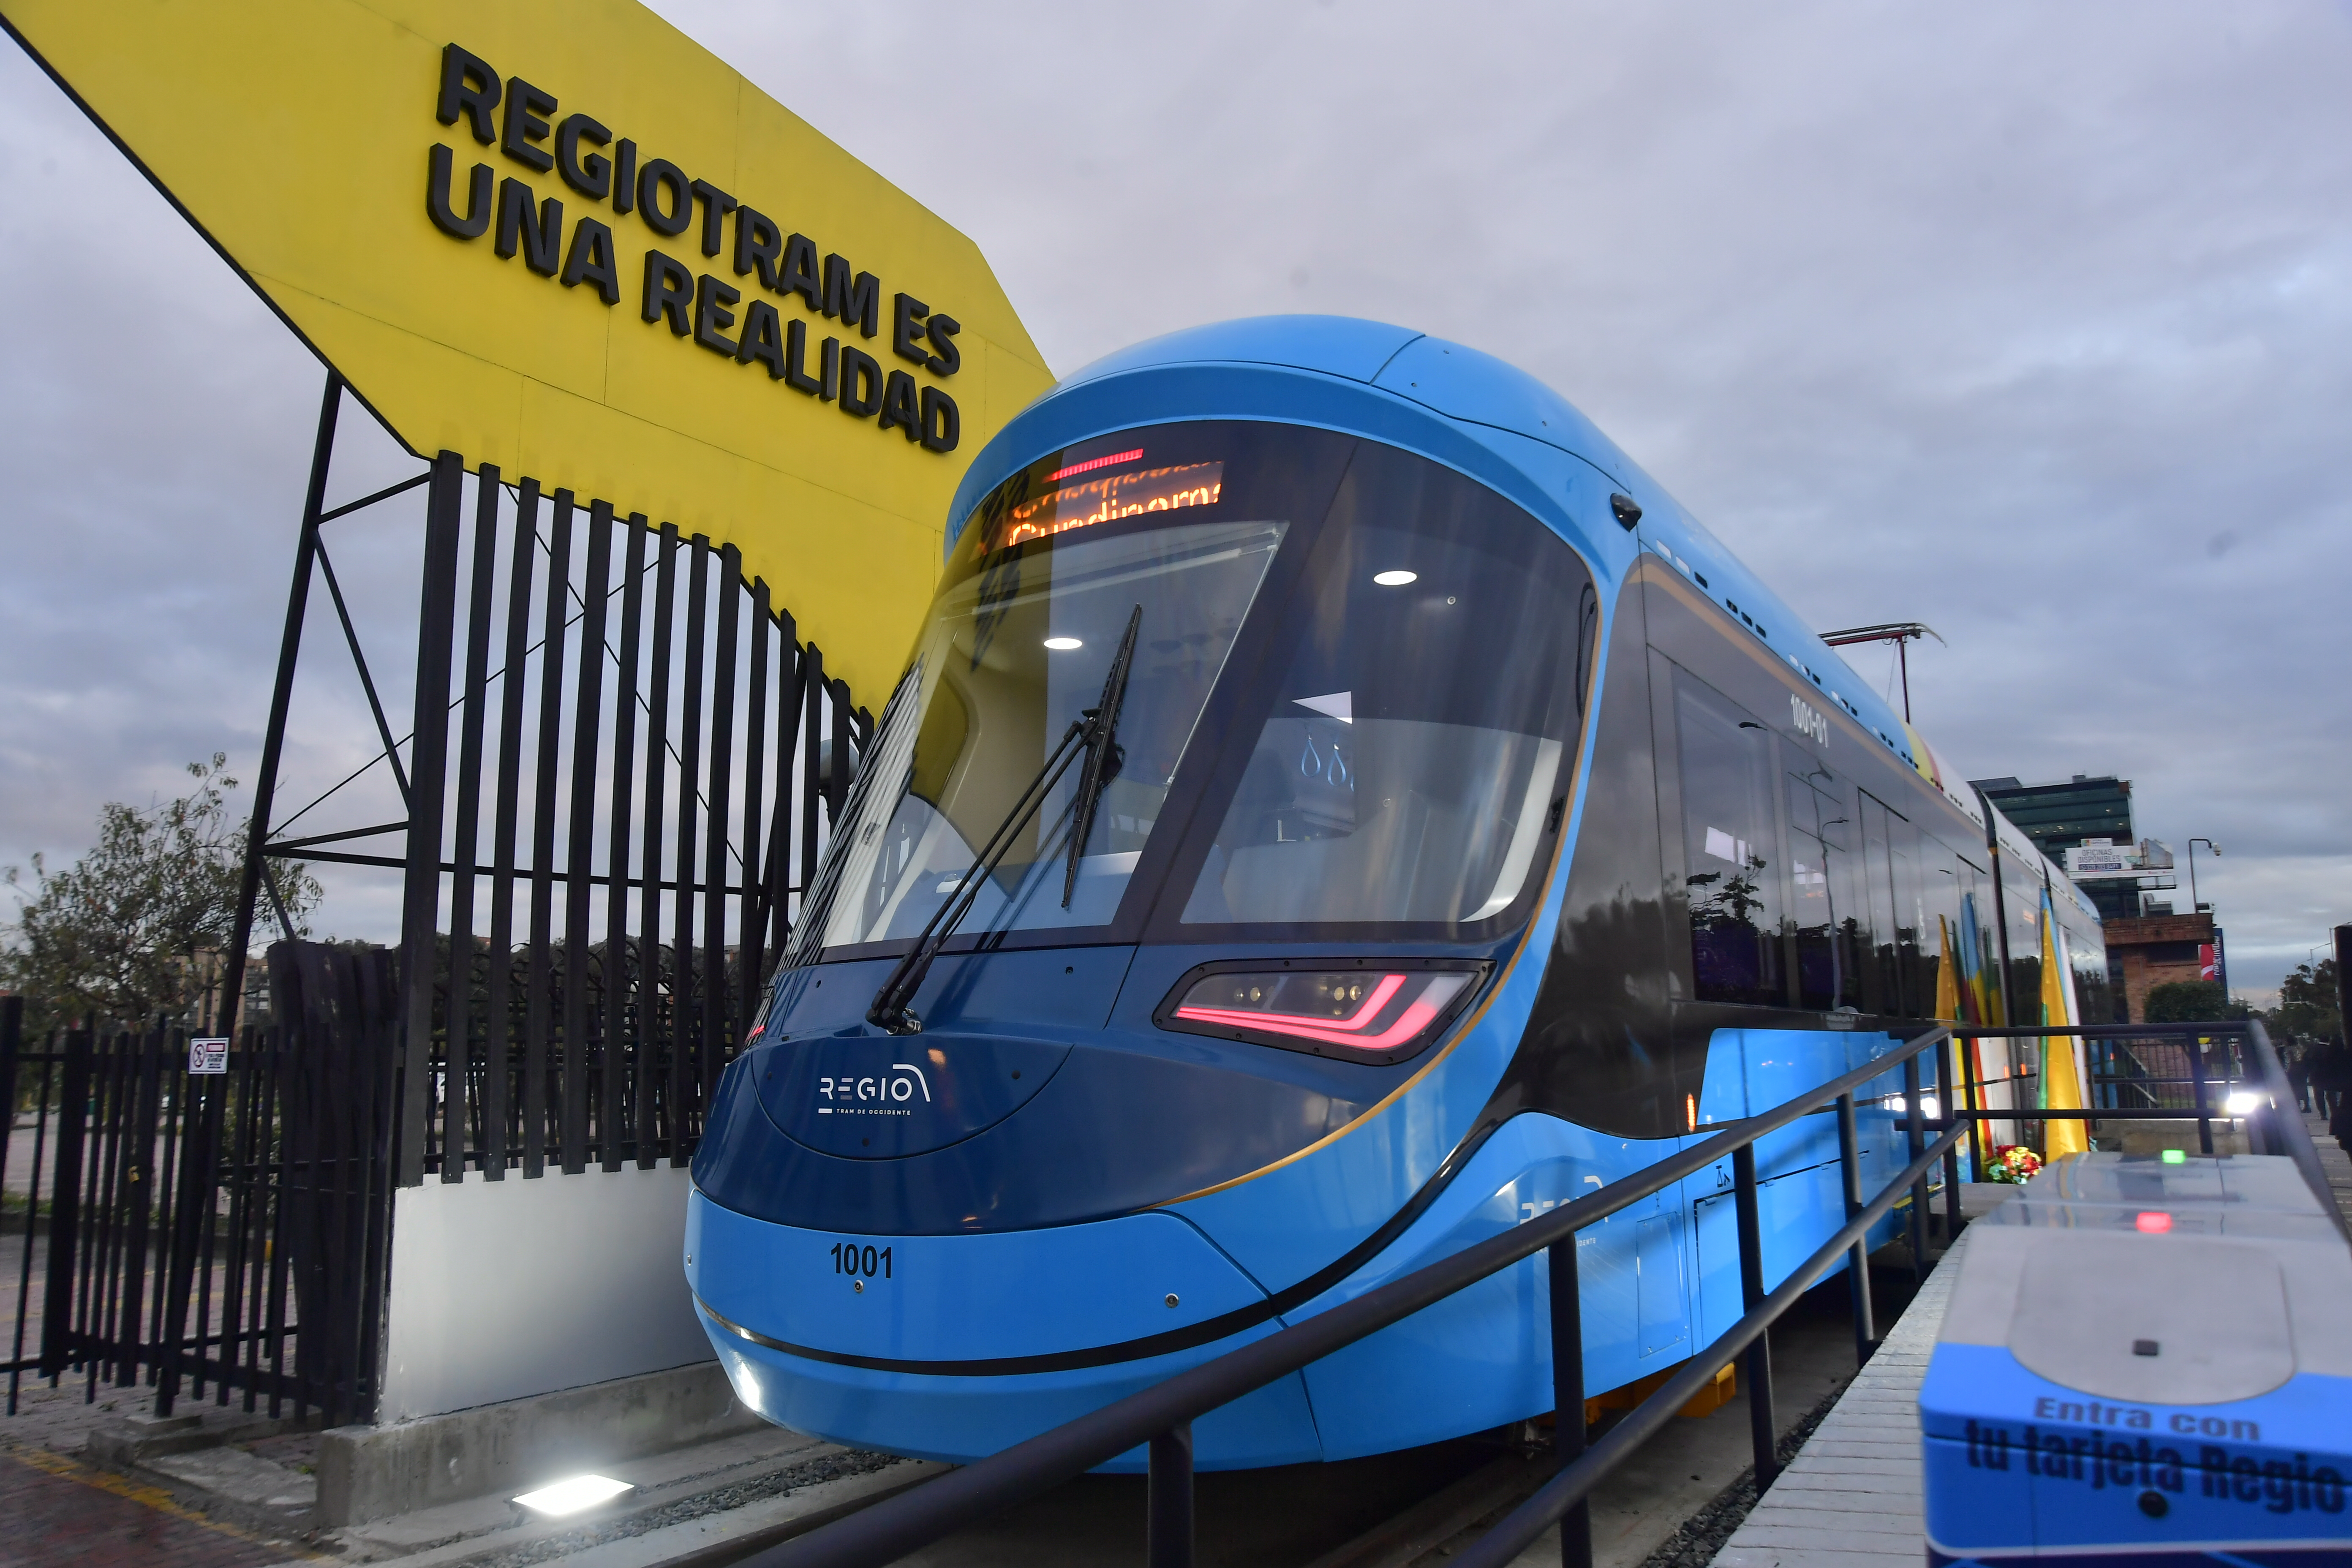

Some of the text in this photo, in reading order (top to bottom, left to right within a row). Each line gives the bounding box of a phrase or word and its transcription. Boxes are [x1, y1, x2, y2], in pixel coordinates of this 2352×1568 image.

[436, 42, 961, 376] REGIOTRAM ES
[425, 142, 960, 453] UNA REALIDAD
[820, 1077, 912, 1101] REGIO
[831, 1243, 891, 1279] 1001
[2034, 1396, 2261, 1441] Entra con
[1964, 1418, 2345, 1514] tu tarjeta Regio
